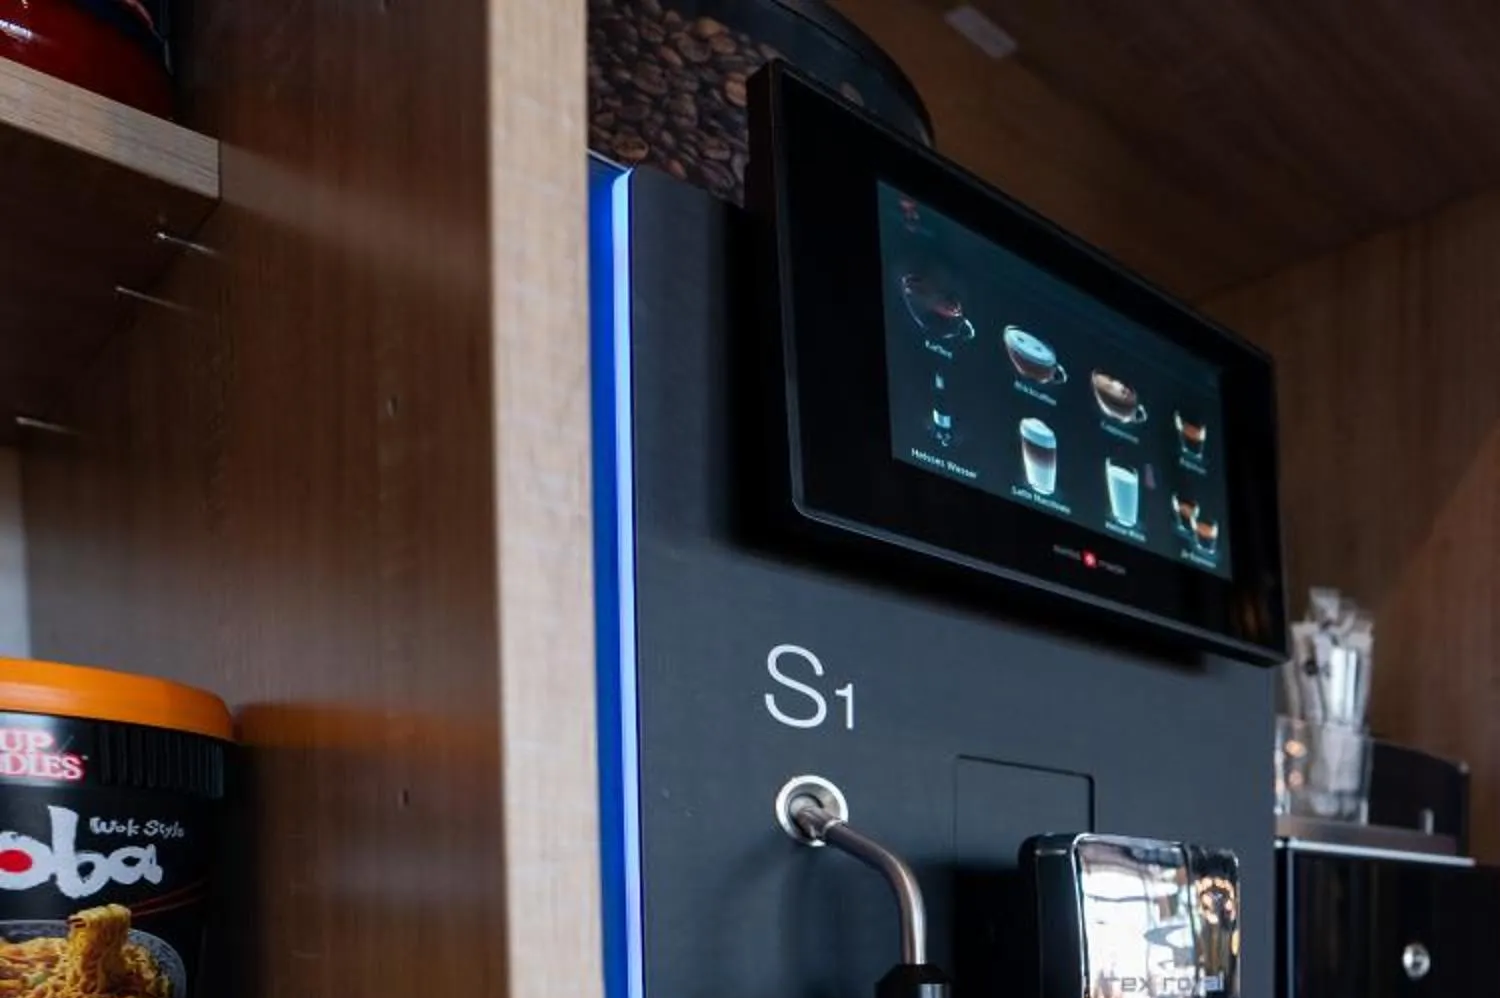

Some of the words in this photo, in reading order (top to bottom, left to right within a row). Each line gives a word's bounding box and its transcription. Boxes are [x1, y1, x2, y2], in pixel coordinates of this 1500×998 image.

[764, 643, 854, 730] S1
[89, 816, 140, 837] Wok
[143, 819, 185, 839] Style
